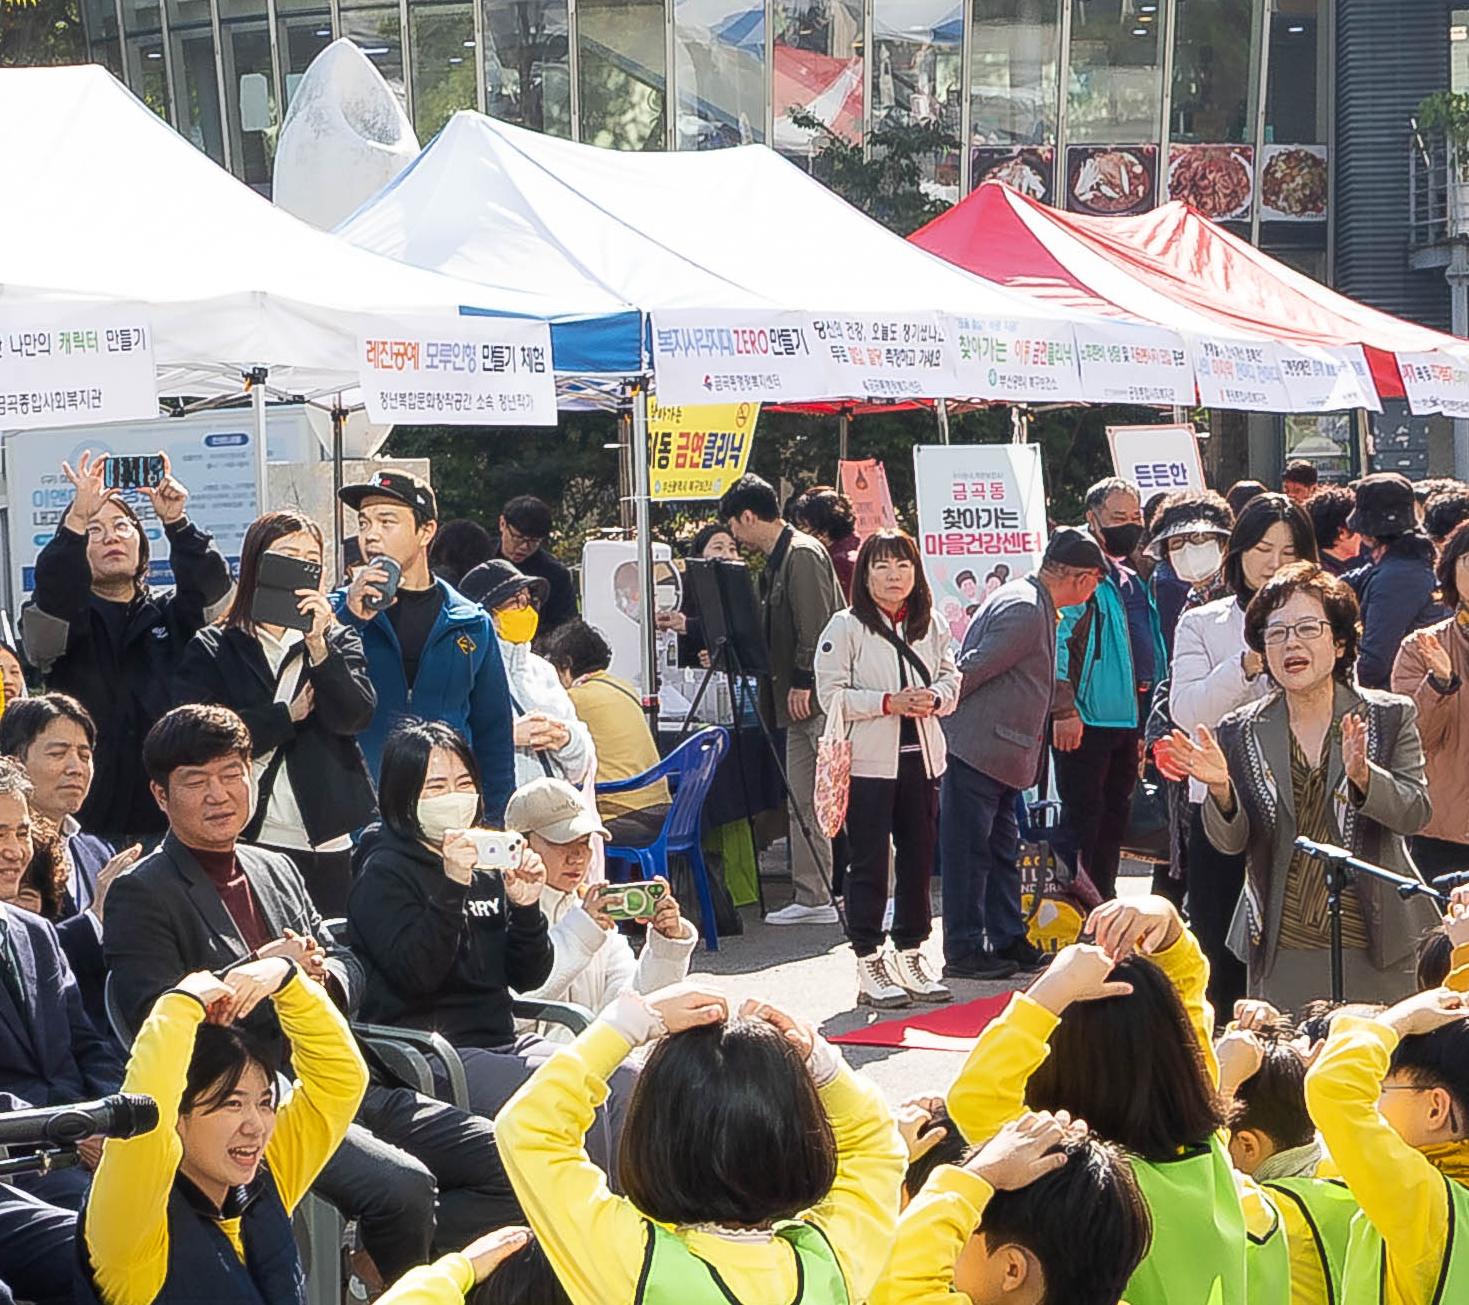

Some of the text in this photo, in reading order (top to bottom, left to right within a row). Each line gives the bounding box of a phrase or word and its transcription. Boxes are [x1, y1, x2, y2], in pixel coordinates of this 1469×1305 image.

[9, 332, 51, 357] 나만의
[58, 330, 99, 354] 캐릭터
[106, 327, 146, 352] 만들기
[733, 329, 768, 355] ZERO
[769, 327, 809, 356] 만들기
[871, 322, 898, 342] 오늘도
[366, 340, 546, 373] 레진공예 모루인형 만들기 체험
[958, 334, 1007, 363] 찾아가는
[380, 391, 472, 411] 청년복합문화창작공간
[674, 431, 746, 470] 금연클리닉
[1134, 462, 1189, 489] 든든한
[952, 481, 1005, 501] 금곡동
[943, 507, 1019, 530] 찾아가는
[925, 532, 1042, 556] 마을건강센터
